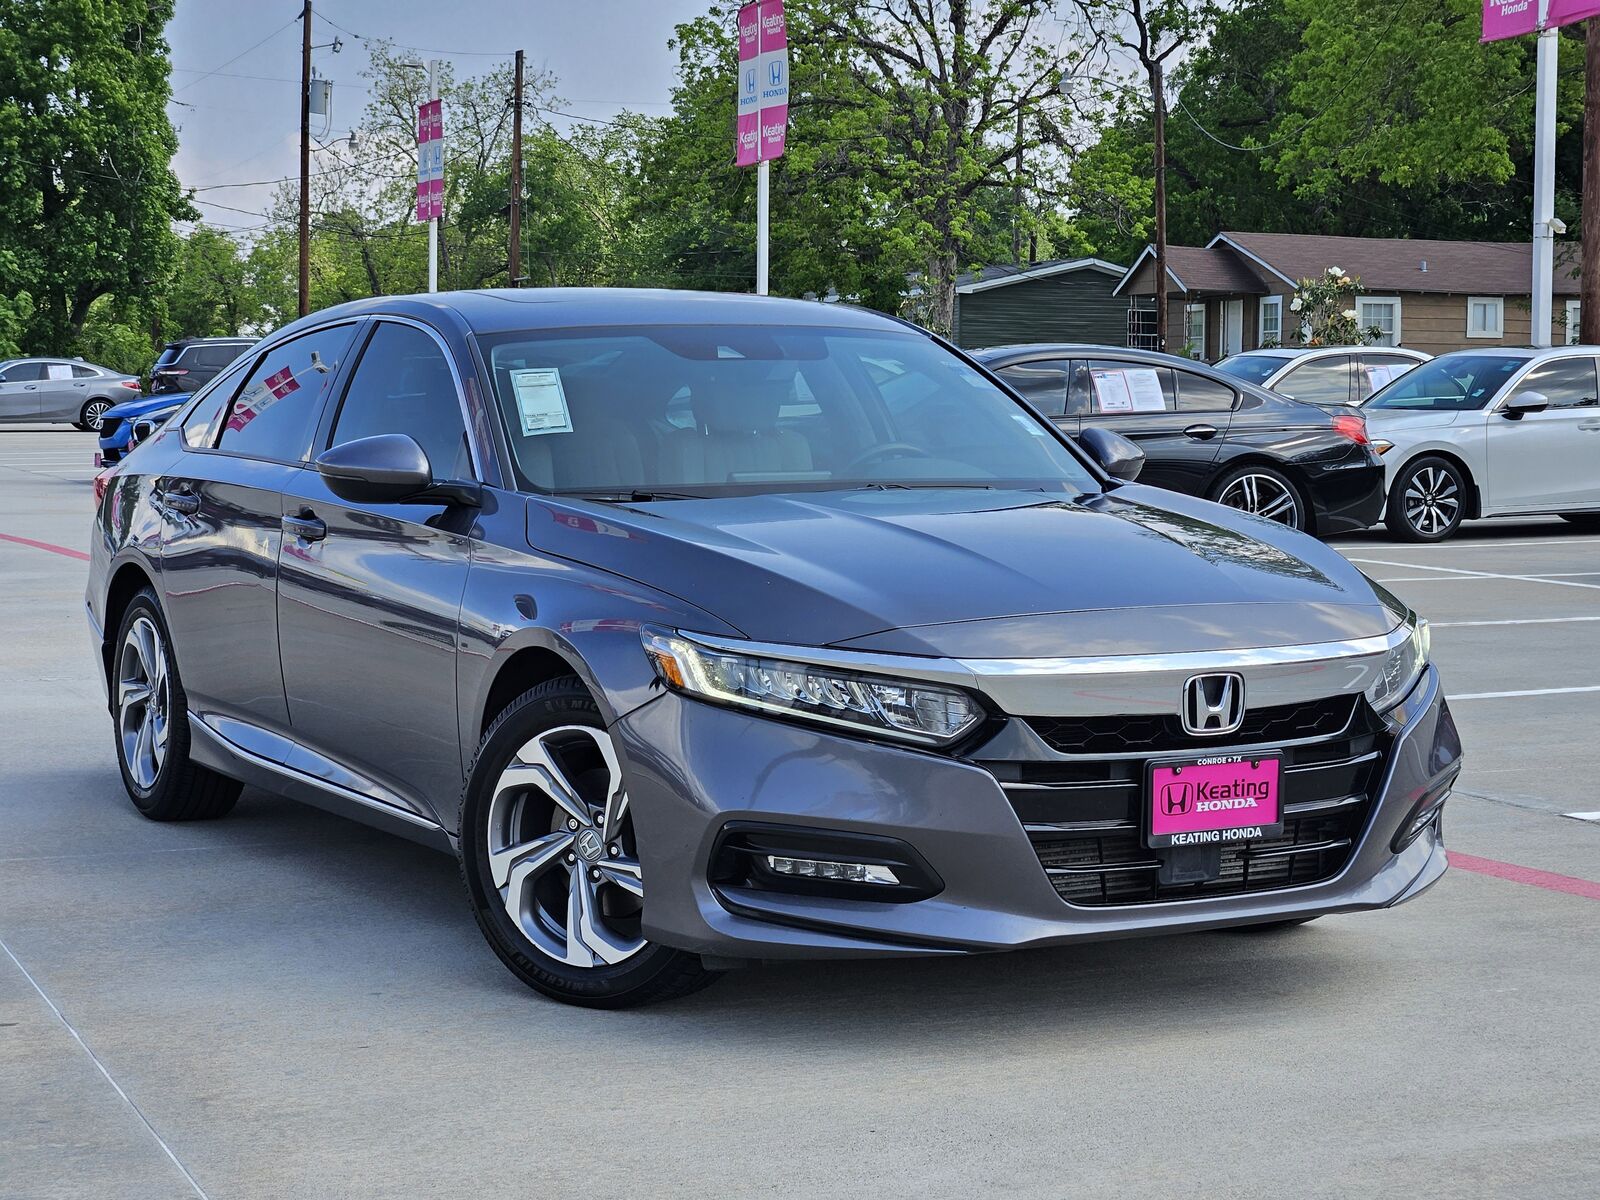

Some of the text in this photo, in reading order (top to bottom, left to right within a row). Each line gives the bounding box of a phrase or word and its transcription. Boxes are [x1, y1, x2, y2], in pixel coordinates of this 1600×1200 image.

[1501, 1, 1528, 17] Honda
[762, 13, 785, 29] Keating
[763, 87, 788, 98] HONDA
[740, 95, 758, 106] HOND
[1197, 757, 1227, 766] CONROE
[1196, 778, 1270, 801] Keating
[1195, 797, 1258, 812] HONDA
[1171, 826, 1263, 845] KEATING HONDA
